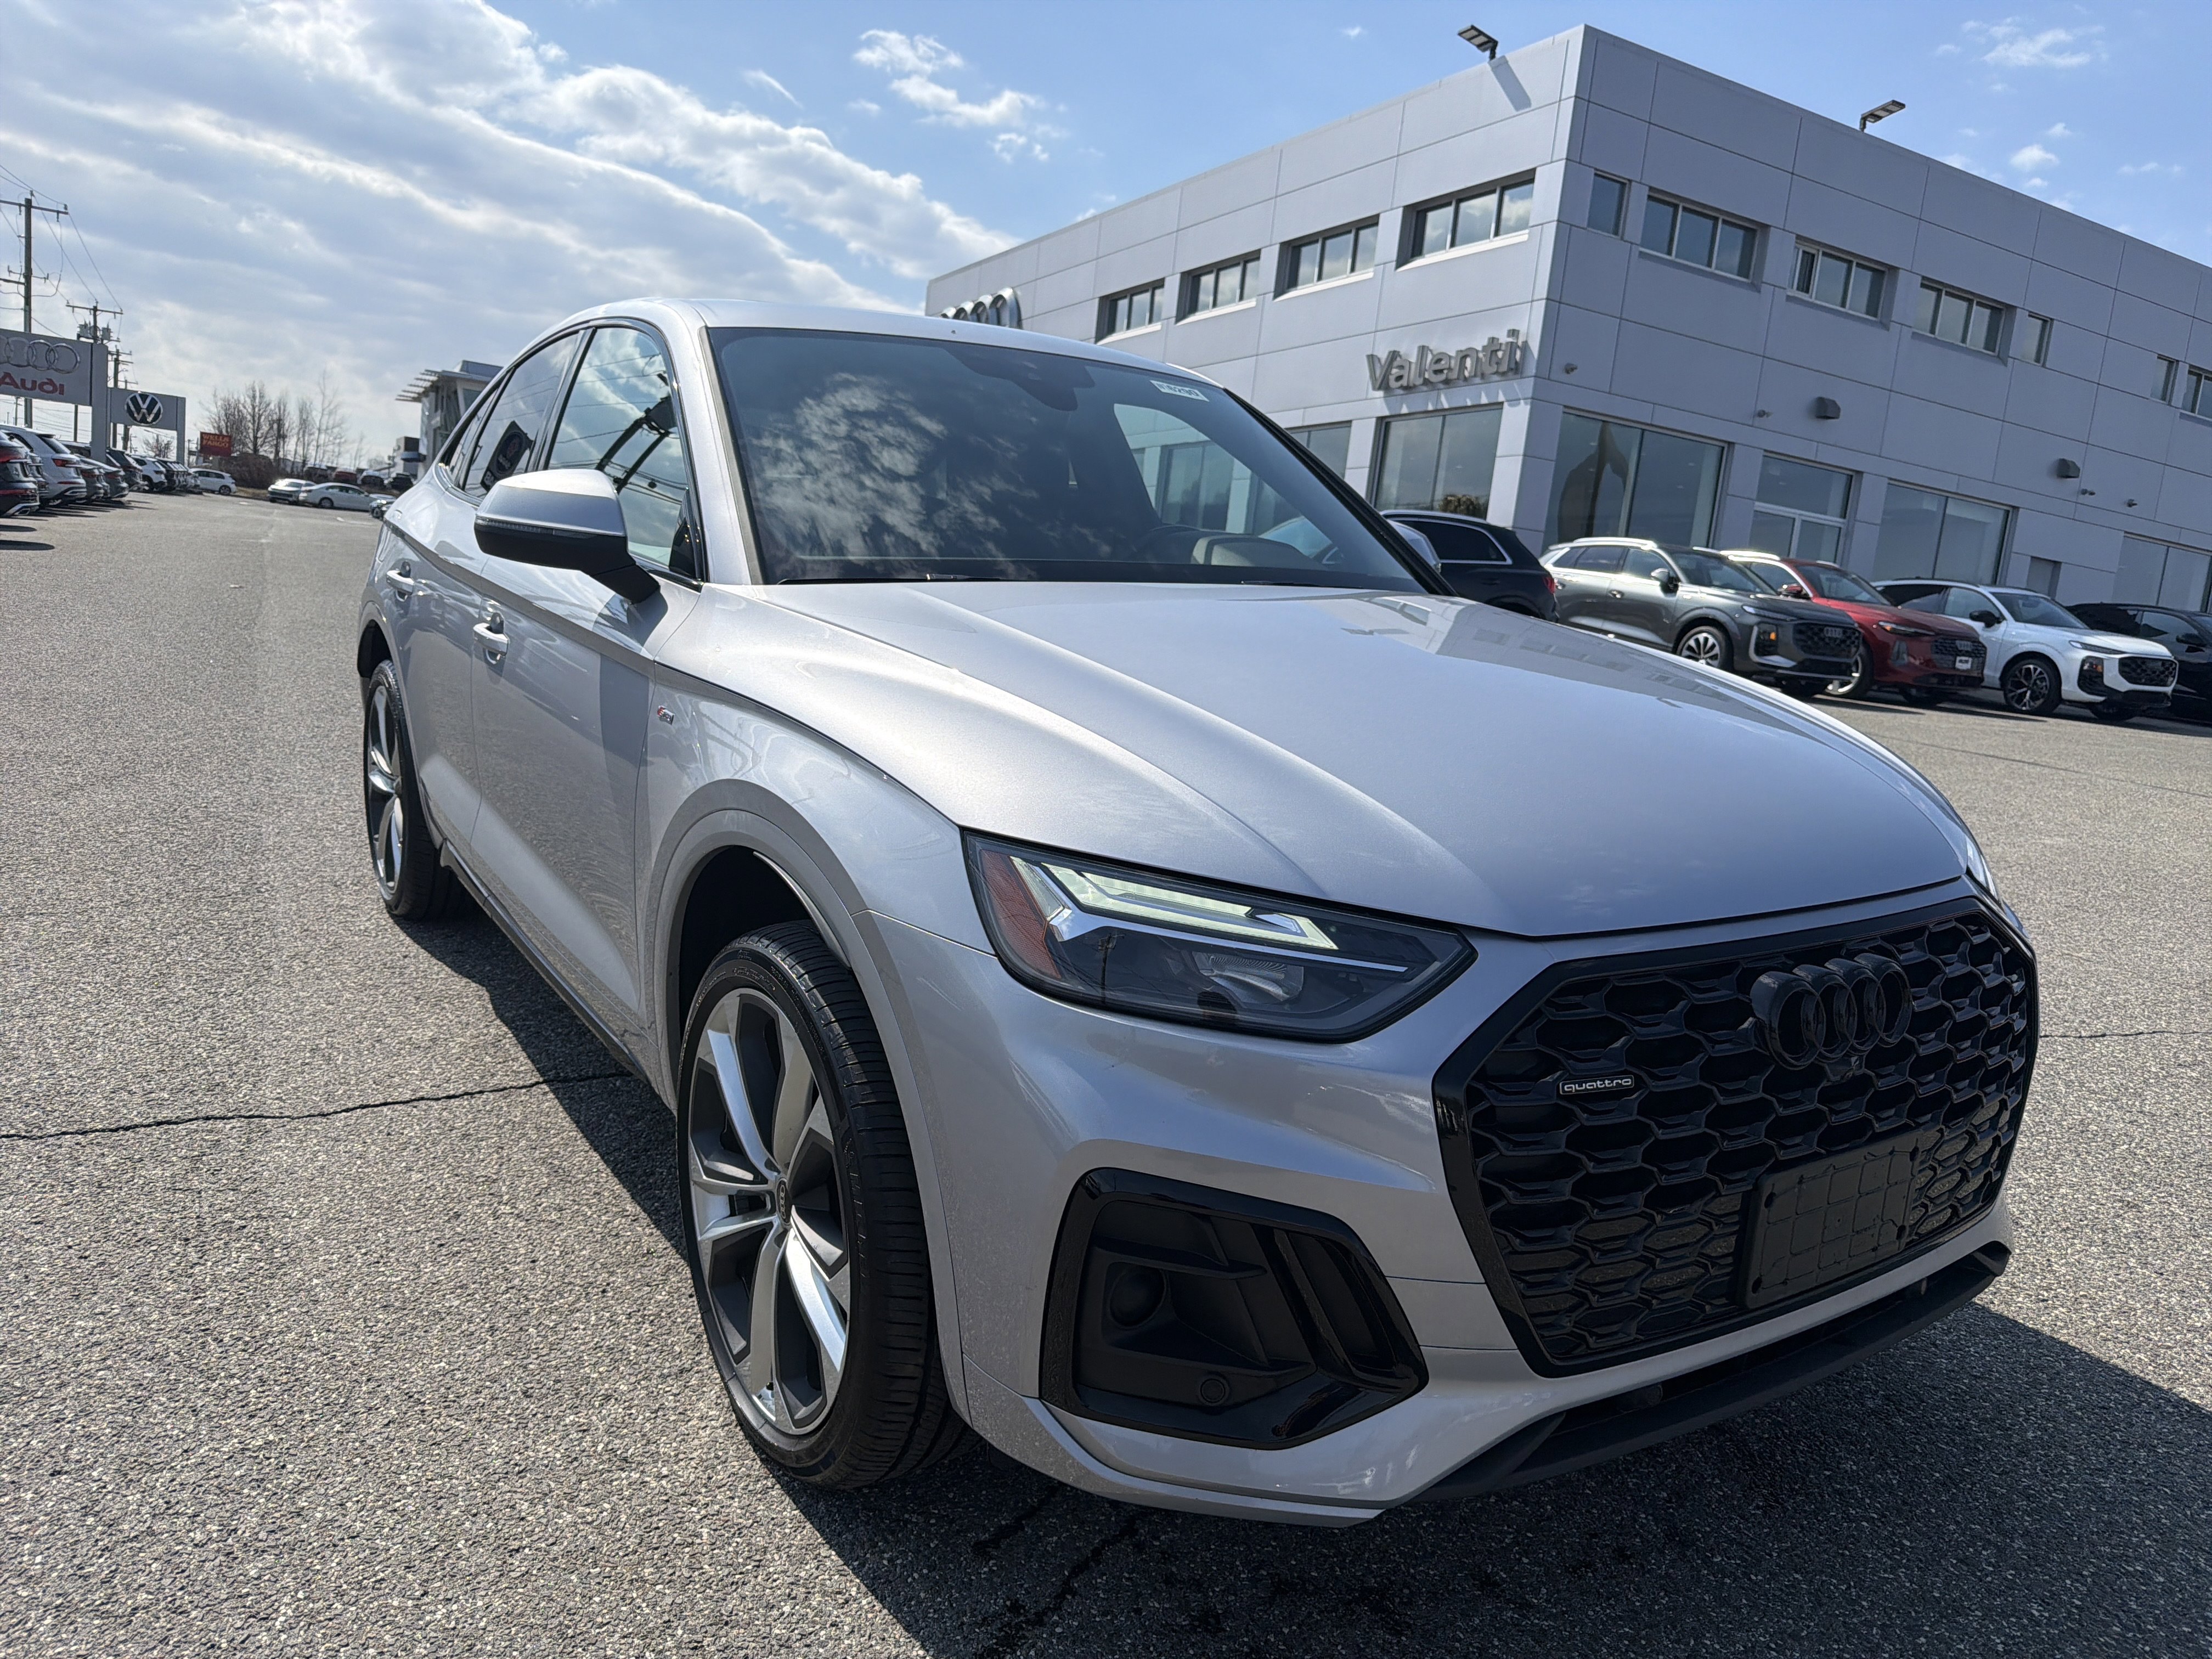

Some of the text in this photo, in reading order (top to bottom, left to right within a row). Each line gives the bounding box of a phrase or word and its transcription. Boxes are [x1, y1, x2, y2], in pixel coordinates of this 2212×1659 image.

[1365, 329, 1521, 391] Valenti
[0, 371, 64, 395] Audi
[1564, 1079, 1632, 1093] quattro
